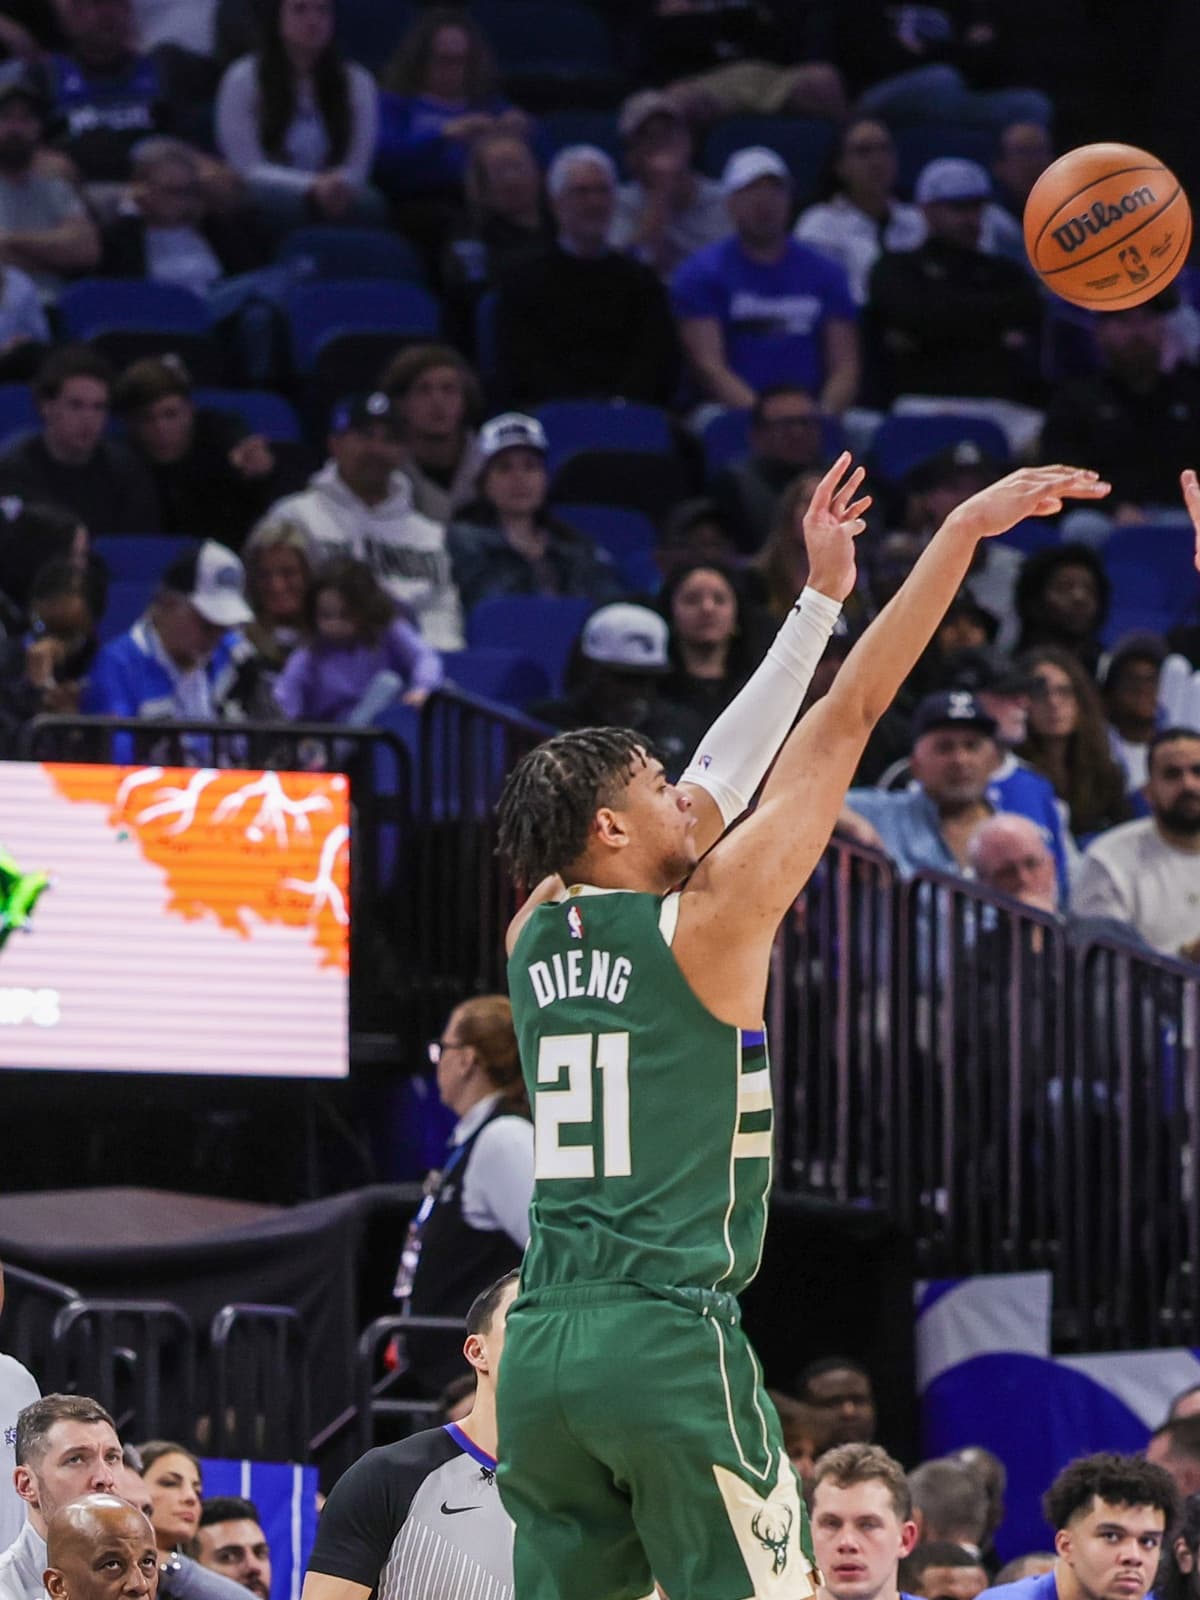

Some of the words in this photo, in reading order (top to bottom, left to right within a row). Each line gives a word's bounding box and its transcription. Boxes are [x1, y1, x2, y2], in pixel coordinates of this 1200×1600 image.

[1052, 186, 1156, 253] Wilson
[528, 950, 633, 1009] DIENG
[535, 1031, 632, 1180] 21
